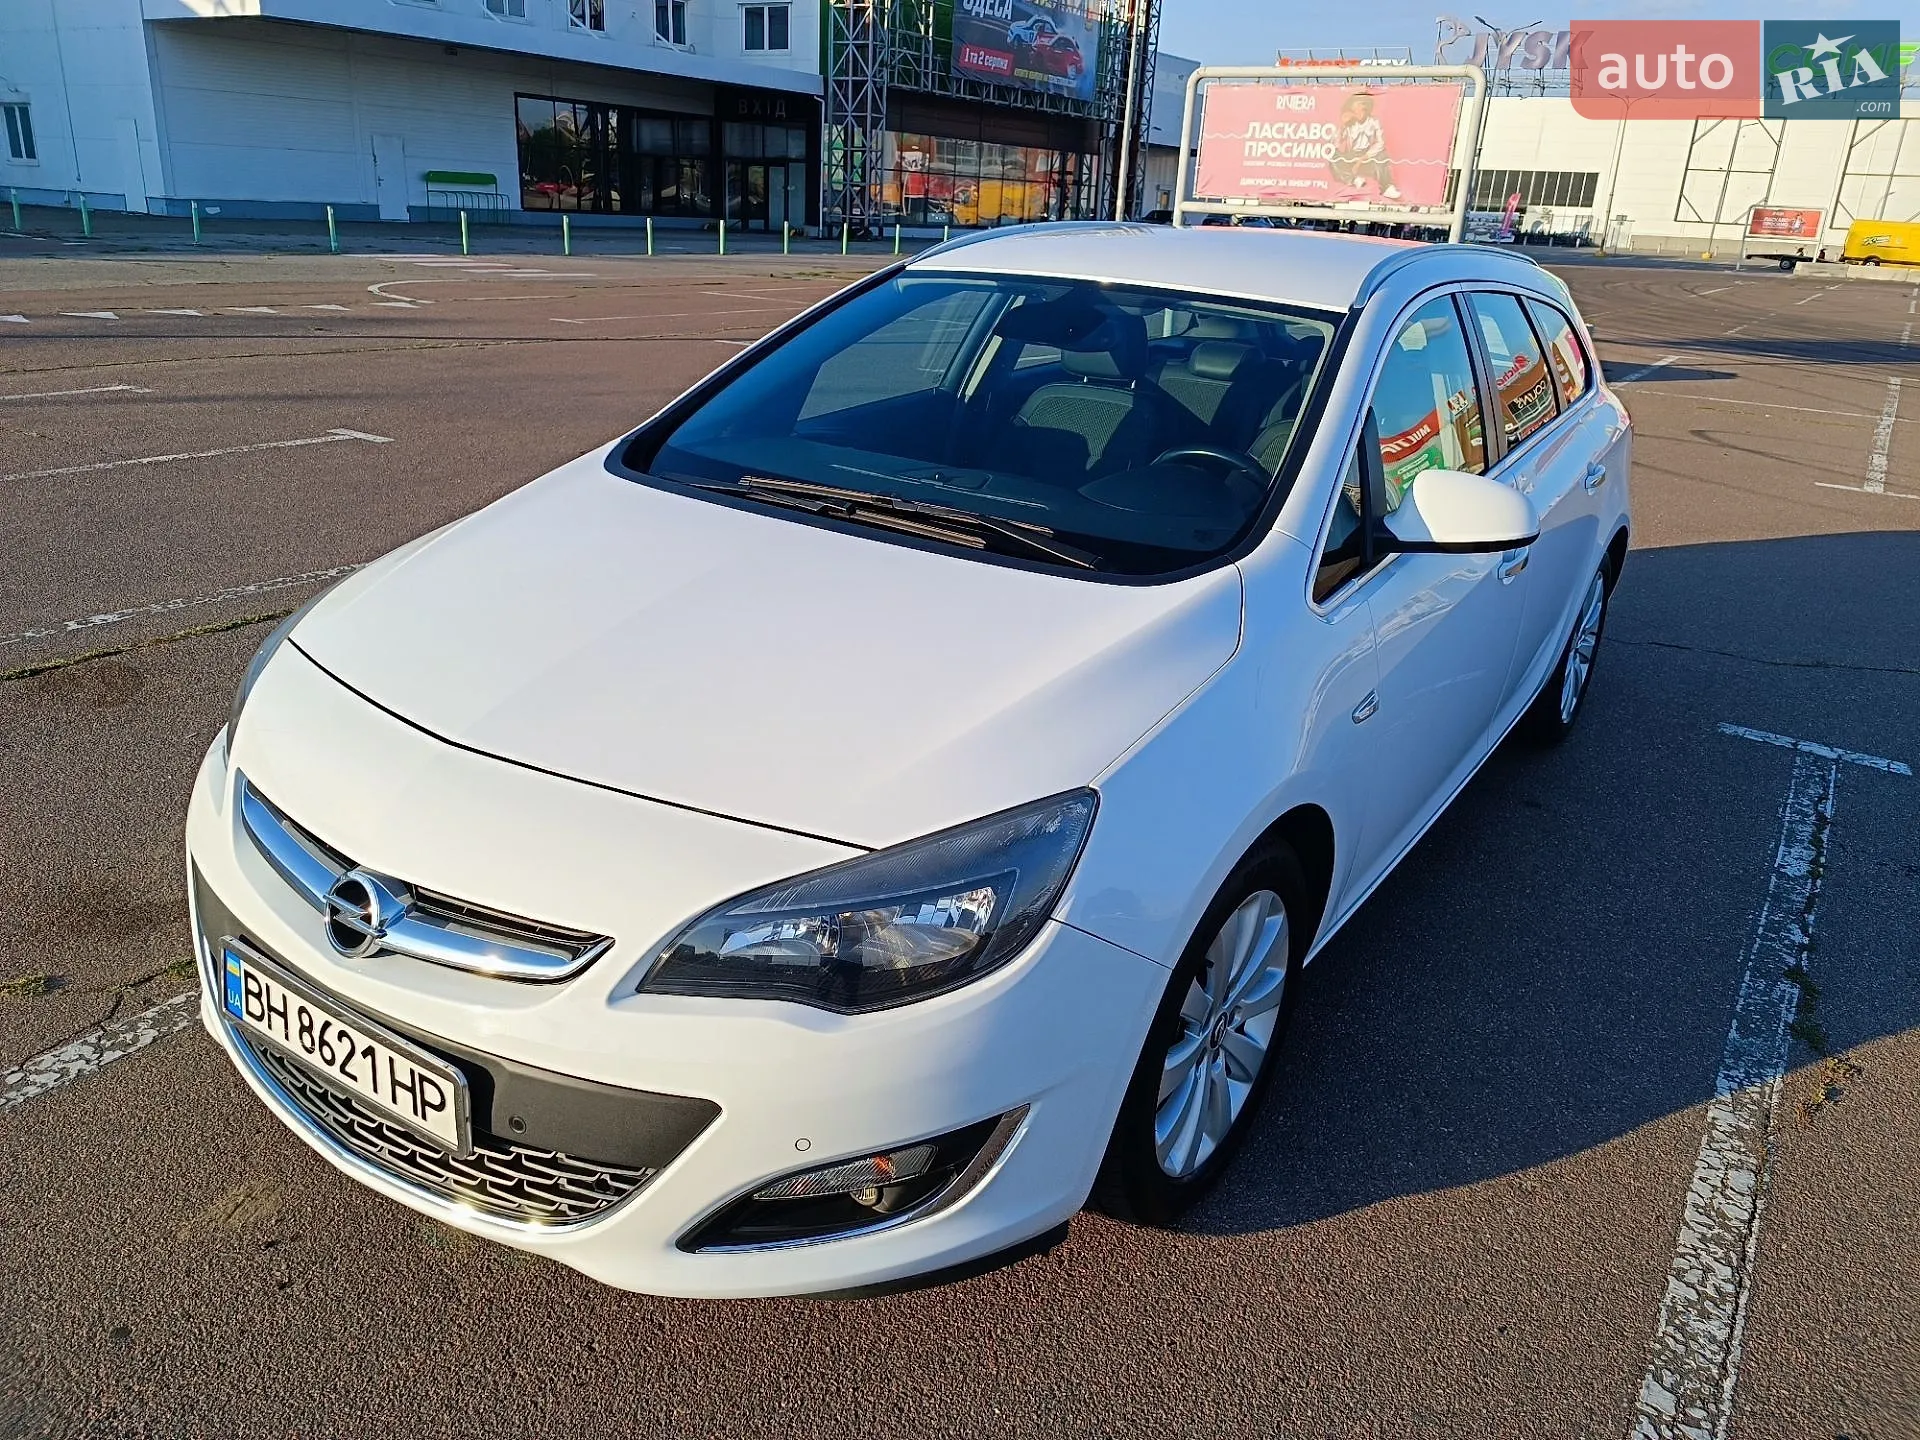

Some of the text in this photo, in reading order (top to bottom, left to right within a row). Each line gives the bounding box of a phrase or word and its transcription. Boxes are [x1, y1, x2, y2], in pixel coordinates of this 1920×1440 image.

[1464, 30, 1595, 70] JYSK
[738, 99, 786, 118] ВХІД
[1276, 95, 1316, 111] RIVIERA
[1246, 121, 1337, 140] ЛАСКАВО
[1244, 141, 1337, 160] ПРОСИМО
[228, 989, 242, 1010] UA
[243, 969, 446, 1122] BH 8621 HP
